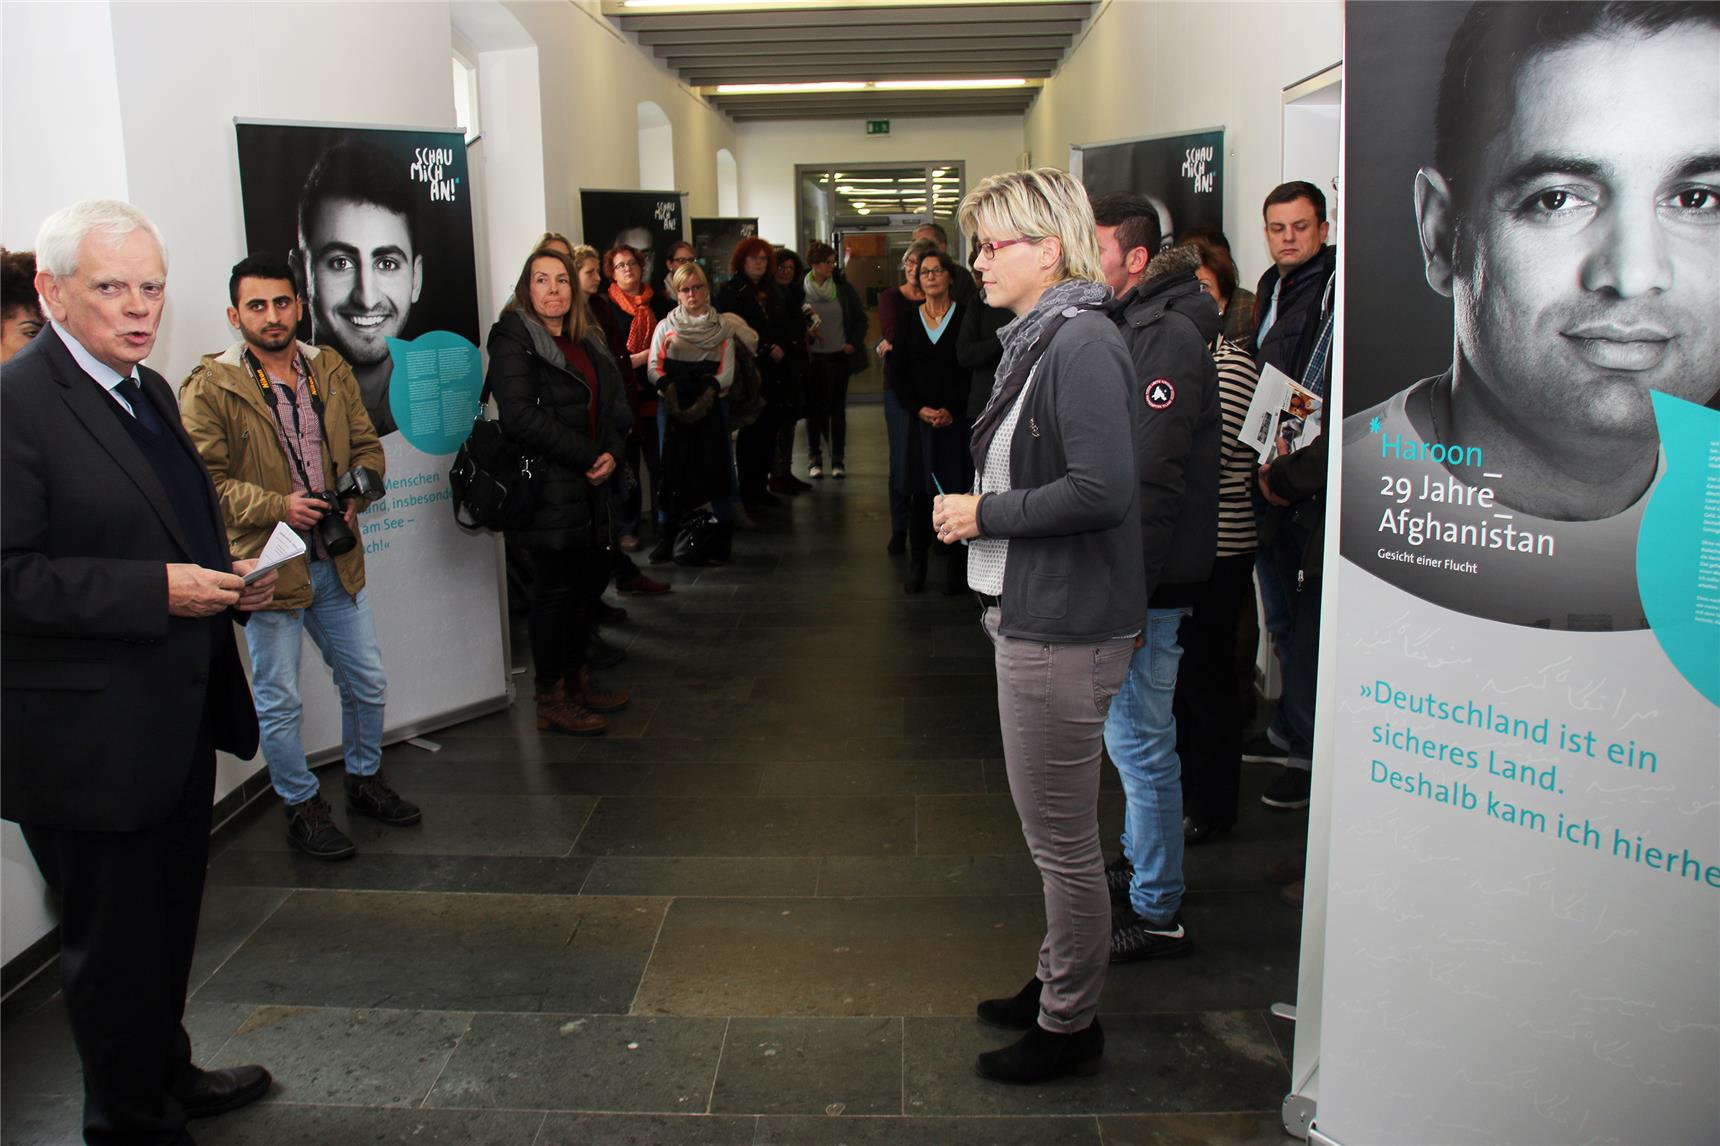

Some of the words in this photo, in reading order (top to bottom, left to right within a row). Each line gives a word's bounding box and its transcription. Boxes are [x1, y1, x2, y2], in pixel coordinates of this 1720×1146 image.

[415, 147, 453, 166] SCHAU
[1185, 146, 1213, 163] SCHAU
[1380, 476, 1412, 504] 29
[362, 522, 381, 535] am
[383, 517, 404, 531] See
[1378, 508, 1555, 556] Afghanistan
[1377, 548, 1415, 564] Gesicht
[1416, 555, 1442, 569] einer
[1444, 559, 1478, 574] Flucht
[1371, 723, 1478, 769] sicheres
[1488, 750, 1565, 795] Land.
[1559, 724, 1597, 758] ist
[1607, 740, 1658, 773] ein
[1370, 759, 1477, 810] Deshalb
[1487, 790, 1546, 833] kam
[1557, 813, 1601, 850] ich
